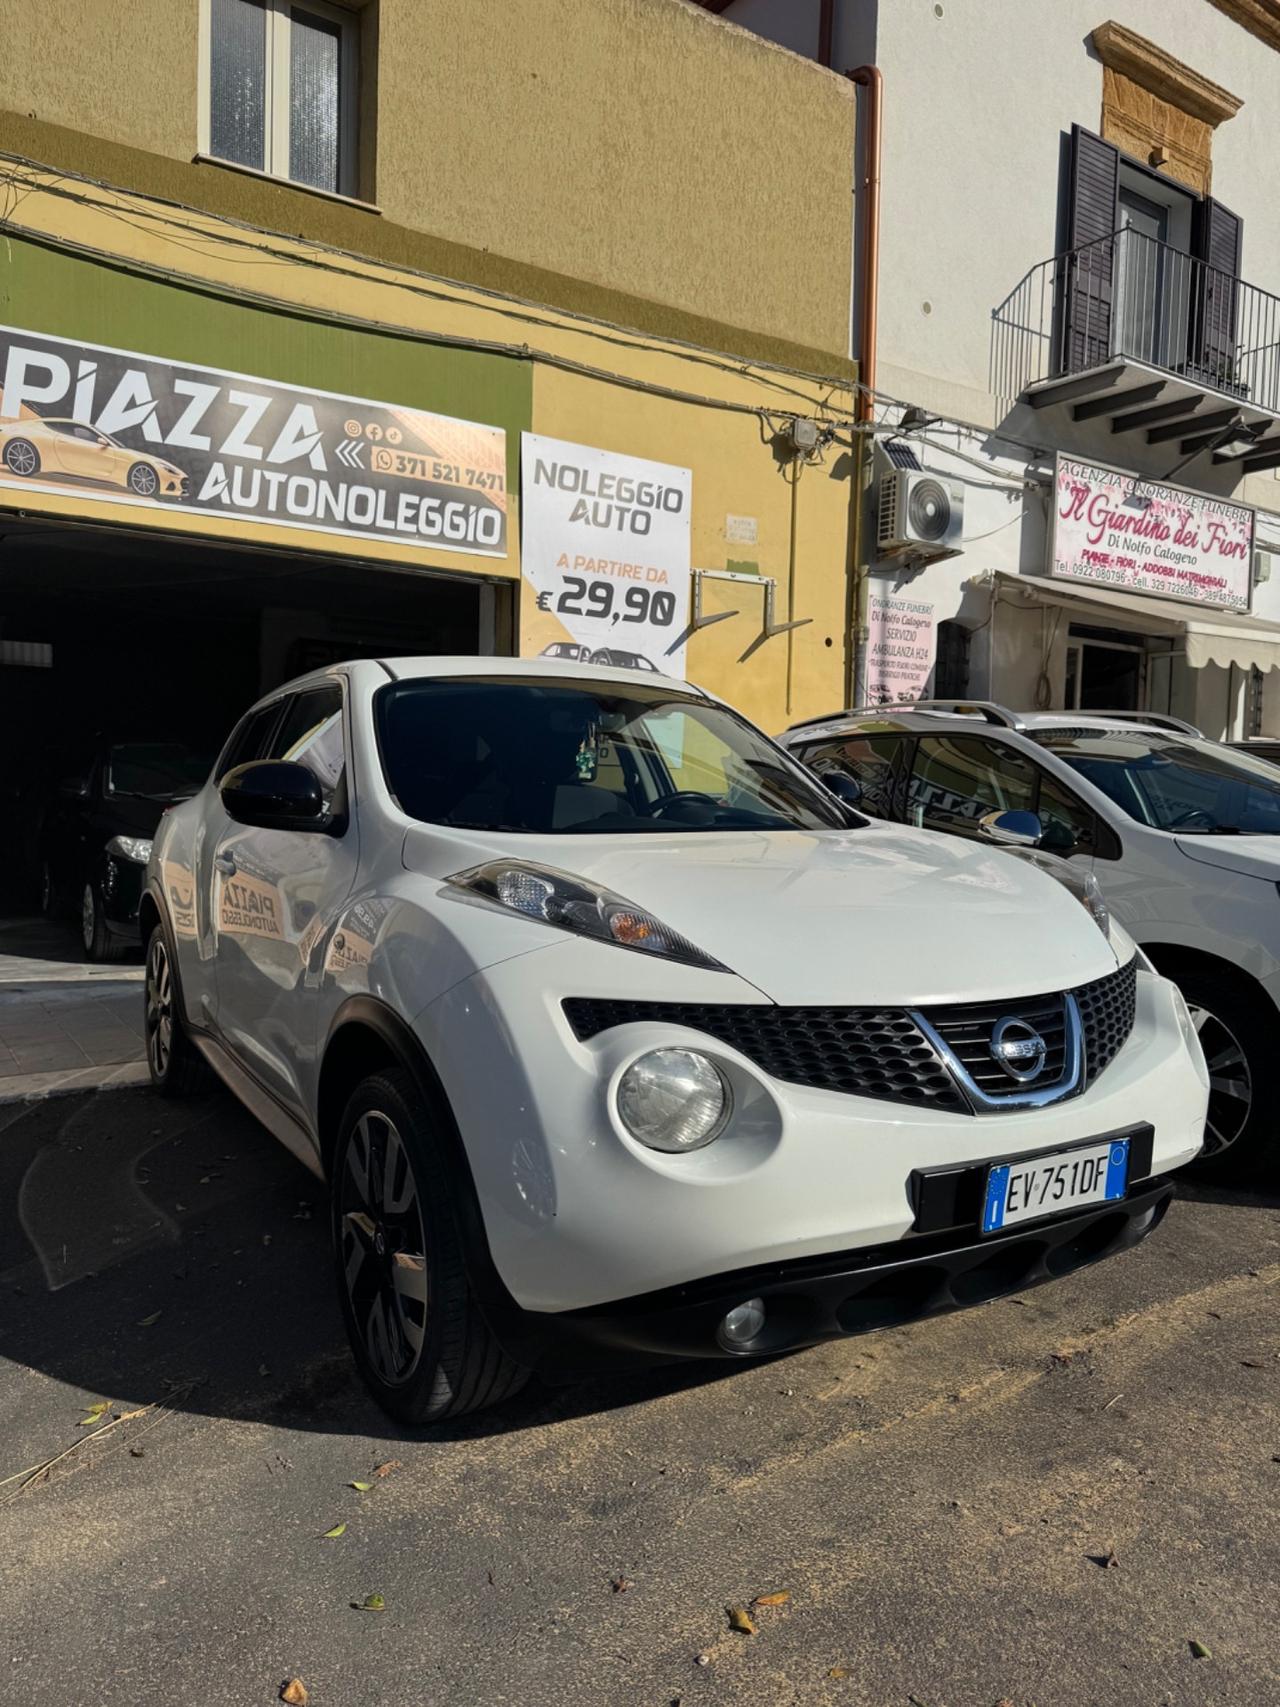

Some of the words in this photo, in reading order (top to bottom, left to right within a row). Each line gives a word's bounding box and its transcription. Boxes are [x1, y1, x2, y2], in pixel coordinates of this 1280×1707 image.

[1, 345, 328, 471] PIAZZA
[396, 455, 427, 477] 371
[432, 463, 460, 483] 521
[465, 468, 505, 492] 7471
[534, 458, 683, 513] NOLEGGIO
[1060, 462, 1122, 488] AGENZIA
[1126, 480, 1198, 509] ONORANZE
[1200, 500, 1250, 522] FUNEBRI
[198, 462, 502, 546] AUTONOLEGGIO
[568, 498, 651, 536] AUTO
[1060, 486, 1091, 520] Il
[1087, 494, 1170, 545] Giardino
[1173, 508, 1200, 548] dei
[1201, 522, 1247, 559] Fiori
[556, 552, 569, 568] A
[574, 555, 644, 580] PARTIRE
[646, 567, 668, 585] DA
[1081, 549, 1110, 564] PIANTE
[1141, 561, 1176, 578] ADDOBBI
[1176, 568, 1228, 588] MATRIMONIALI
[1107, 534, 1120, 549] Di
[1122, 537, 1151, 556] Nolfo
[1153, 544, 1198, 566] Calogero
[1055, 559, 1070, 573] Tel.
[1073, 562, 1093, 577] 0922
[1095, 567, 1125, 583] 080796
[535, 590, 553, 612] €
[557, 575, 676, 627] 29,90
[872, 643, 914, 658] AMBULANZA
[887, 628, 917, 642] SERVIZIO
[1006, 1171, 1036, 1213] EV
[1039, 1155, 1108, 1204] 751DF
